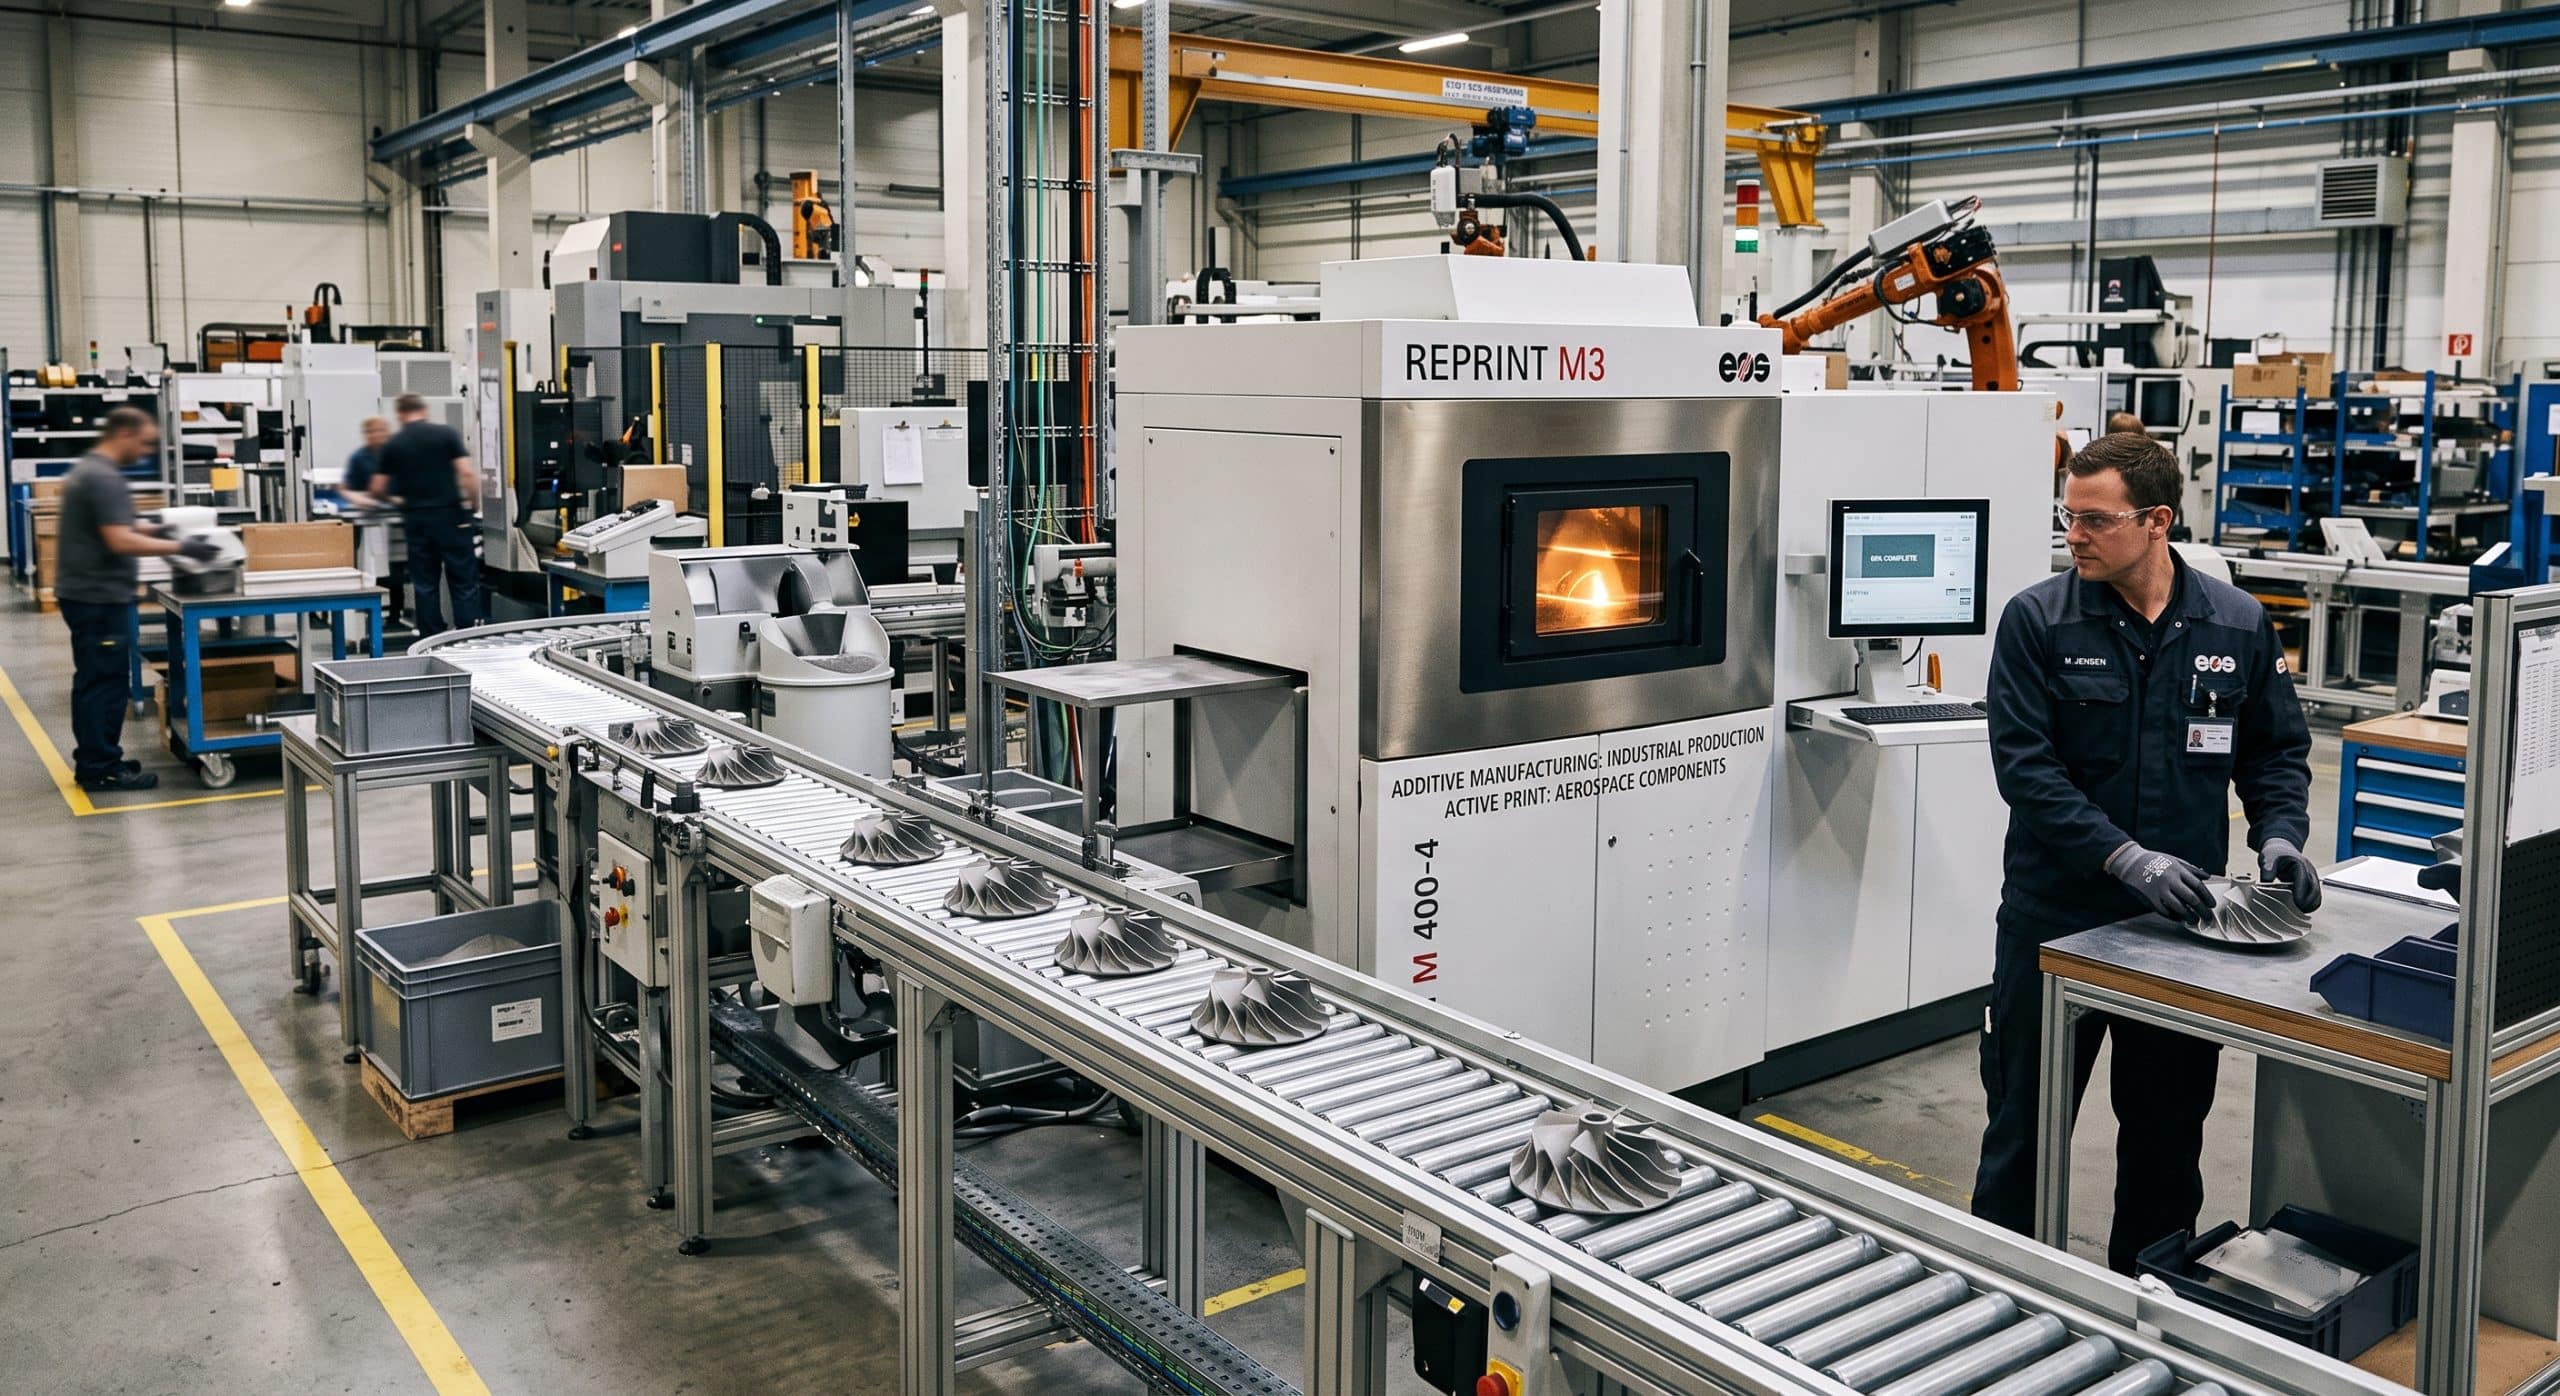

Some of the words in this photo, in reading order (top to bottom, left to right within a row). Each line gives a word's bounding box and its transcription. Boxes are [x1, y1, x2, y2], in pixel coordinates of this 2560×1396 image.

[1406, 344, 1548, 381] REPRINT
[1559, 346, 1605, 381] M3
[2074, 657, 2107, 666] JENSEN
[1391, 771, 1465, 798] ADDITIVE
[1470, 752, 1603, 788] MANUFACTURING:
[1607, 740, 1684, 767] INDUSTRIAL
[1688, 726, 1765, 754] PRODUCTION
[1444, 794, 1499, 819] ACTIVE
[1504, 786, 1551, 810] PRINT:
[1555, 772, 1635, 802] AEROSPACE
[1639, 757, 1727, 788] COMPONENTS
[1413, 838, 1439, 940] 400-4
[1413, 952, 1438, 984] M
